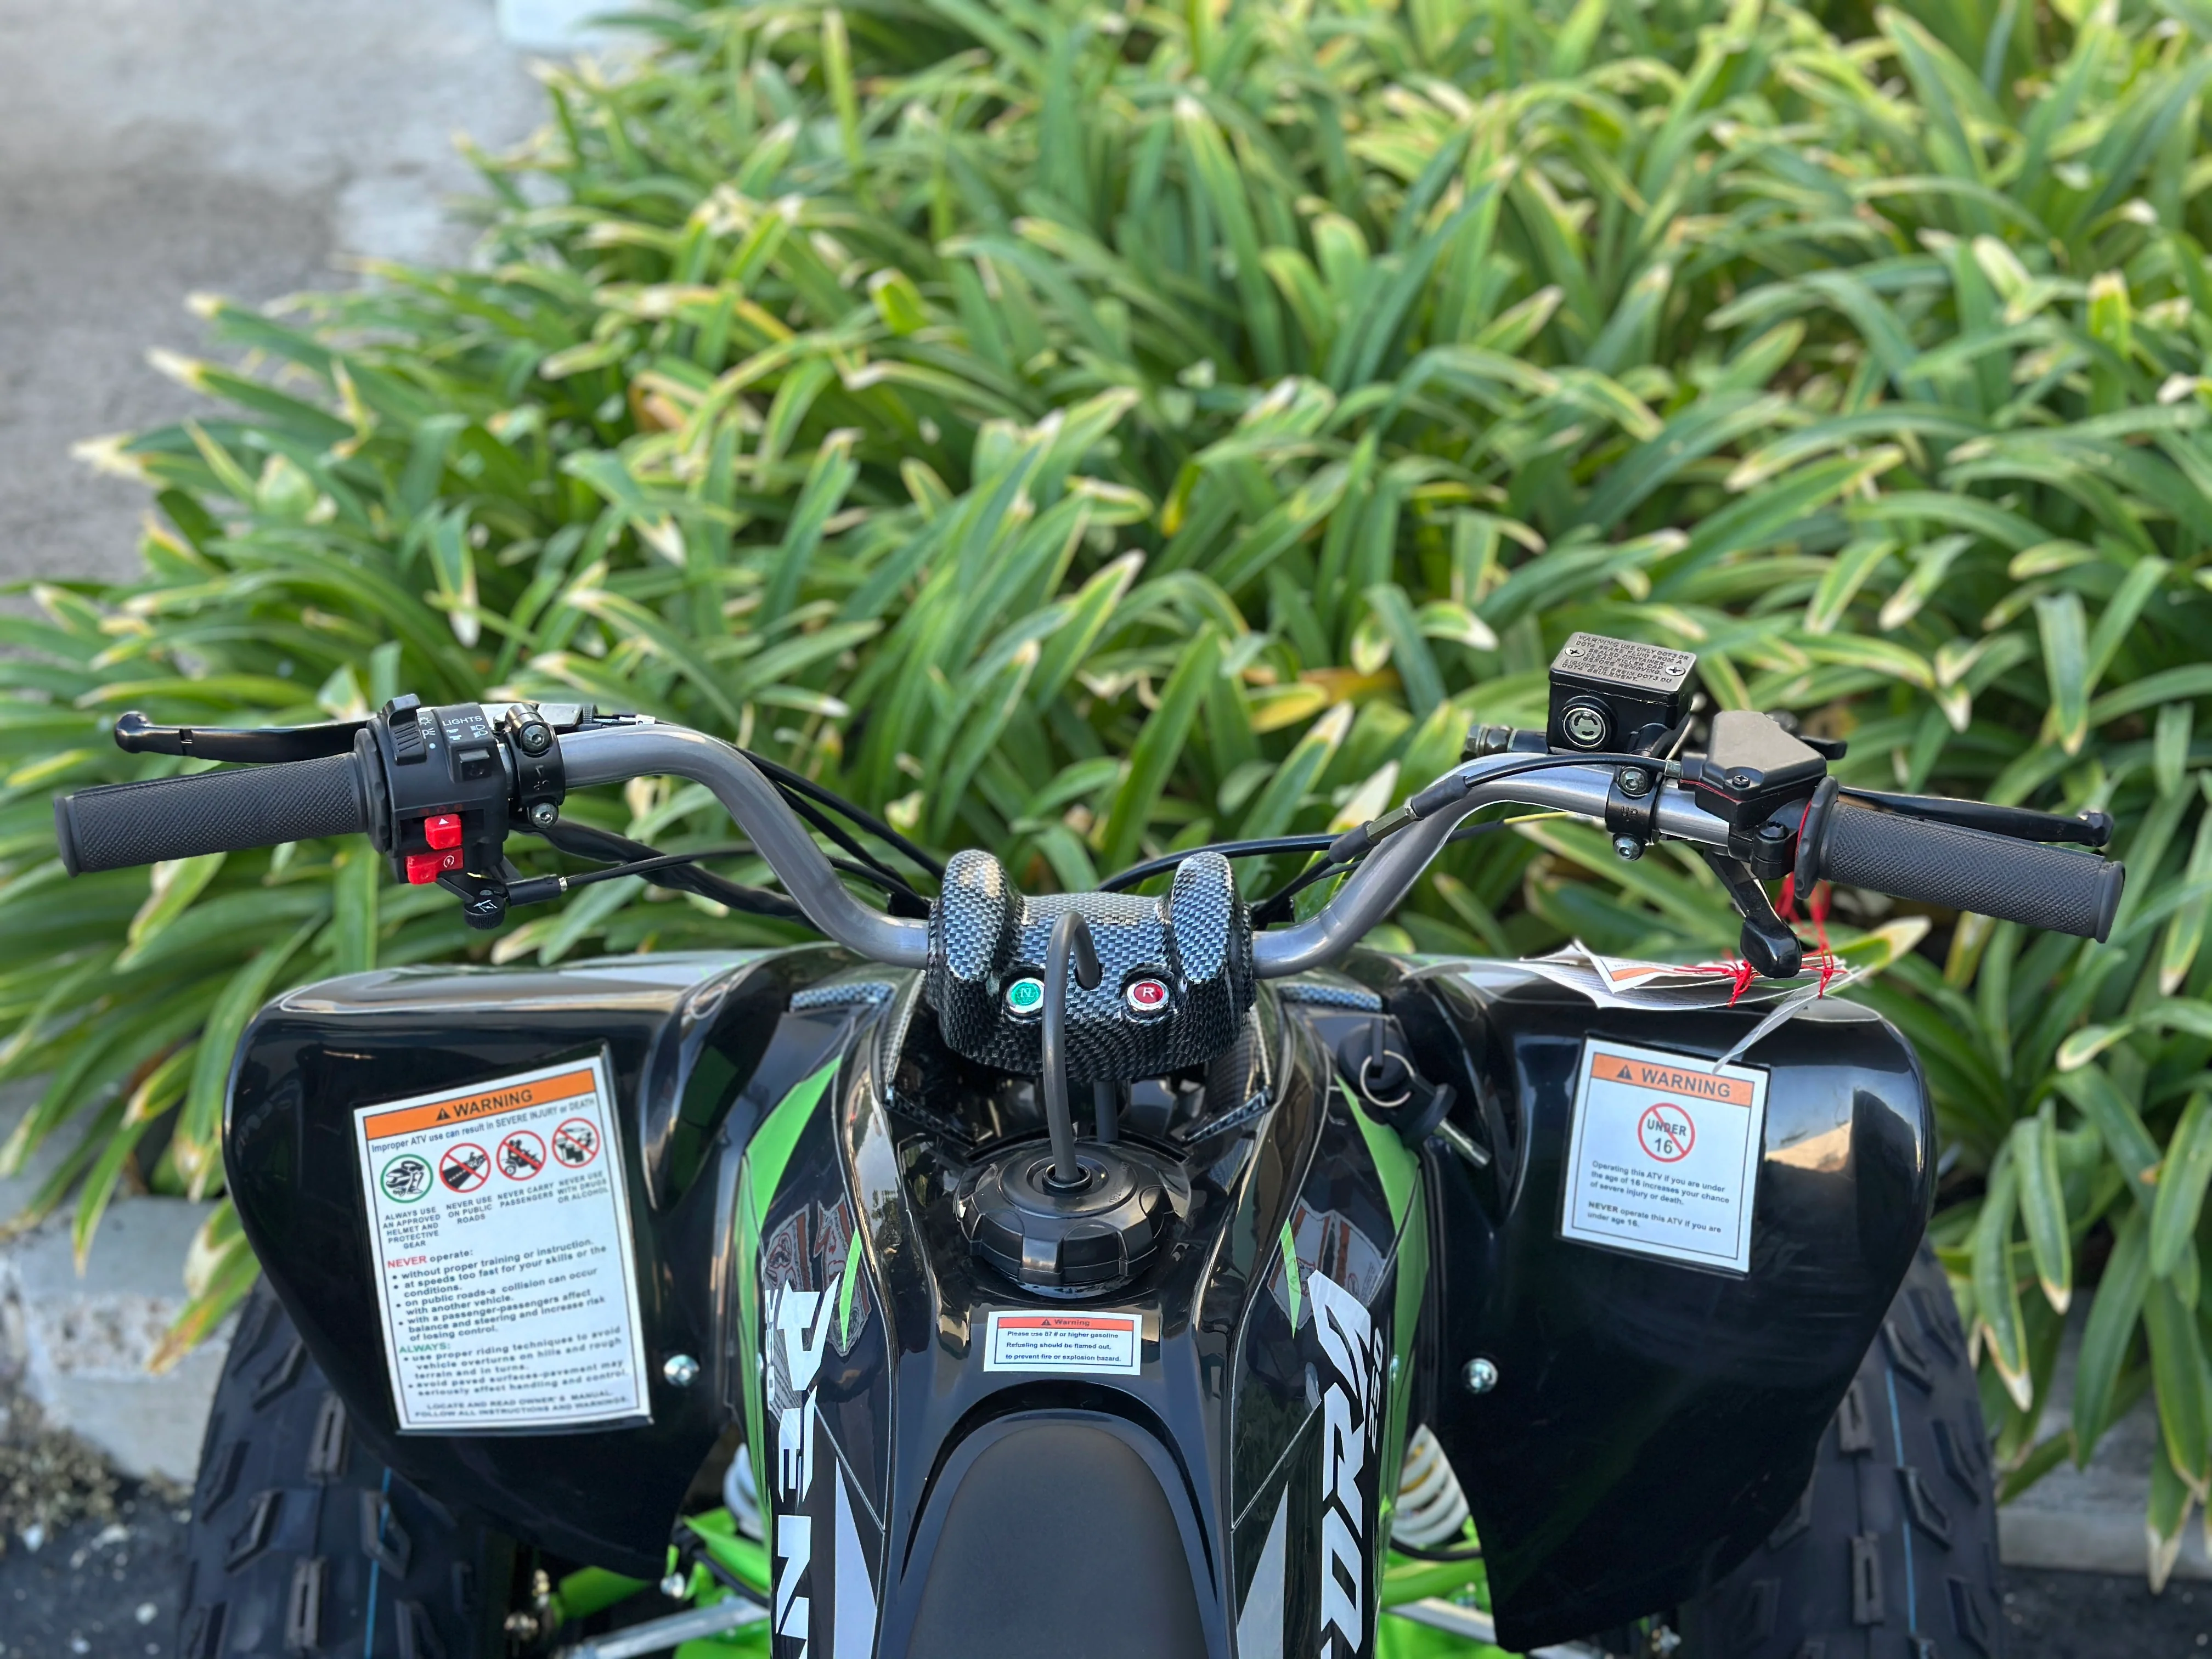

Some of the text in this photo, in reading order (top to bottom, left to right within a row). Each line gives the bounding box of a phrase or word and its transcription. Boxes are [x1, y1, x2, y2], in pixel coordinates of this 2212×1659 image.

[442, 715, 483, 726] LIGHTS
[1020, 987, 1031, 997] N
[1143, 986, 1155, 998] R
[1640, 1068, 1729, 1097] WARNING
[453, 1090, 532, 1116] WARNING
[371, 1140, 408, 1152] Improper
[411, 1135, 426, 1145] ATV
[462, 1124, 484, 1134] result
[495, 1113, 527, 1127] SEVERE
[529, 1107, 556, 1119] INJURY
[569, 1098, 597, 1110] DEATH
[1646, 1119, 1686, 1136] UNDER
[1655, 1137, 1674, 1154] 16
[1592, 1161, 1628, 1175] Operating
[1631, 1169, 1644, 1177] this
[1646, 1171, 1662, 1180] ATV
[1702, 1183, 1725, 1192] under
[498, 1182, 552, 1199] NEVER CARRY
[500, 1191, 552, 1207] PASSENGERS
[1600, 1184, 1624, 1193] severe
[1626, 1188, 1647, 1199] injury
[1660, 1195, 1683, 1204] death.
[1643, 1182, 1679, 1193] increases
[1701, 1193, 1729, 1203] chance
[446, 1195, 492, 1209] NEVER USE
[462, 1204, 492, 1215] PUBLIC
[385, 1206, 436, 1220] ALWAYS USE
[397, 1214, 440, 1226] APPROVED
[457, 1214, 485, 1223] ROADS
[1588, 1201, 1617, 1212] NEVER
[1620, 1209, 1649, 1218] operate
[1651, 1214, 1664, 1222] this
[1667, 1217, 1683, 1225] ATV
[386, 1226, 417, 1235] HELMET
[388, 1230, 438, 1243] PROTECTIVE
[403, 1240, 425, 1249] GEAR
[387, 1250, 472, 1267] NEVER operate:
[402, 1267, 440, 1278] without
[444, 1262, 477, 1274] proper
[481, 1254, 520, 1266] training
[418, 1276, 455, 1286] speeds
[478, 1267, 498, 1276] fast
[519, 1260, 541, 1271] your
[545, 1254, 572, 1264] skills
[576, 1250, 586, 1258] or
[590, 1246, 606, 1254] the
[421, 1295, 453, 1306] public
[502, 1279, 545, 1291] collision
[548, 1275, 566, 1283] can
[569, 1268, 596, 1279] occur
[562, 1289, 590, 1300] affect
[408, 1323, 448, 1333] balance
[475, 1314, 516, 1324] steering
[520, 1309, 538, 1317] and
[541, 1302, 583, 1313] increase
[586, 1296, 604, 1305] risk
[431, 1302, 470, 1312] another
[1368, 1327, 1383, 1454] 250
[776, 1273, 840, 1659] PEN
[1308, 1269, 1371, 1659] ORA
